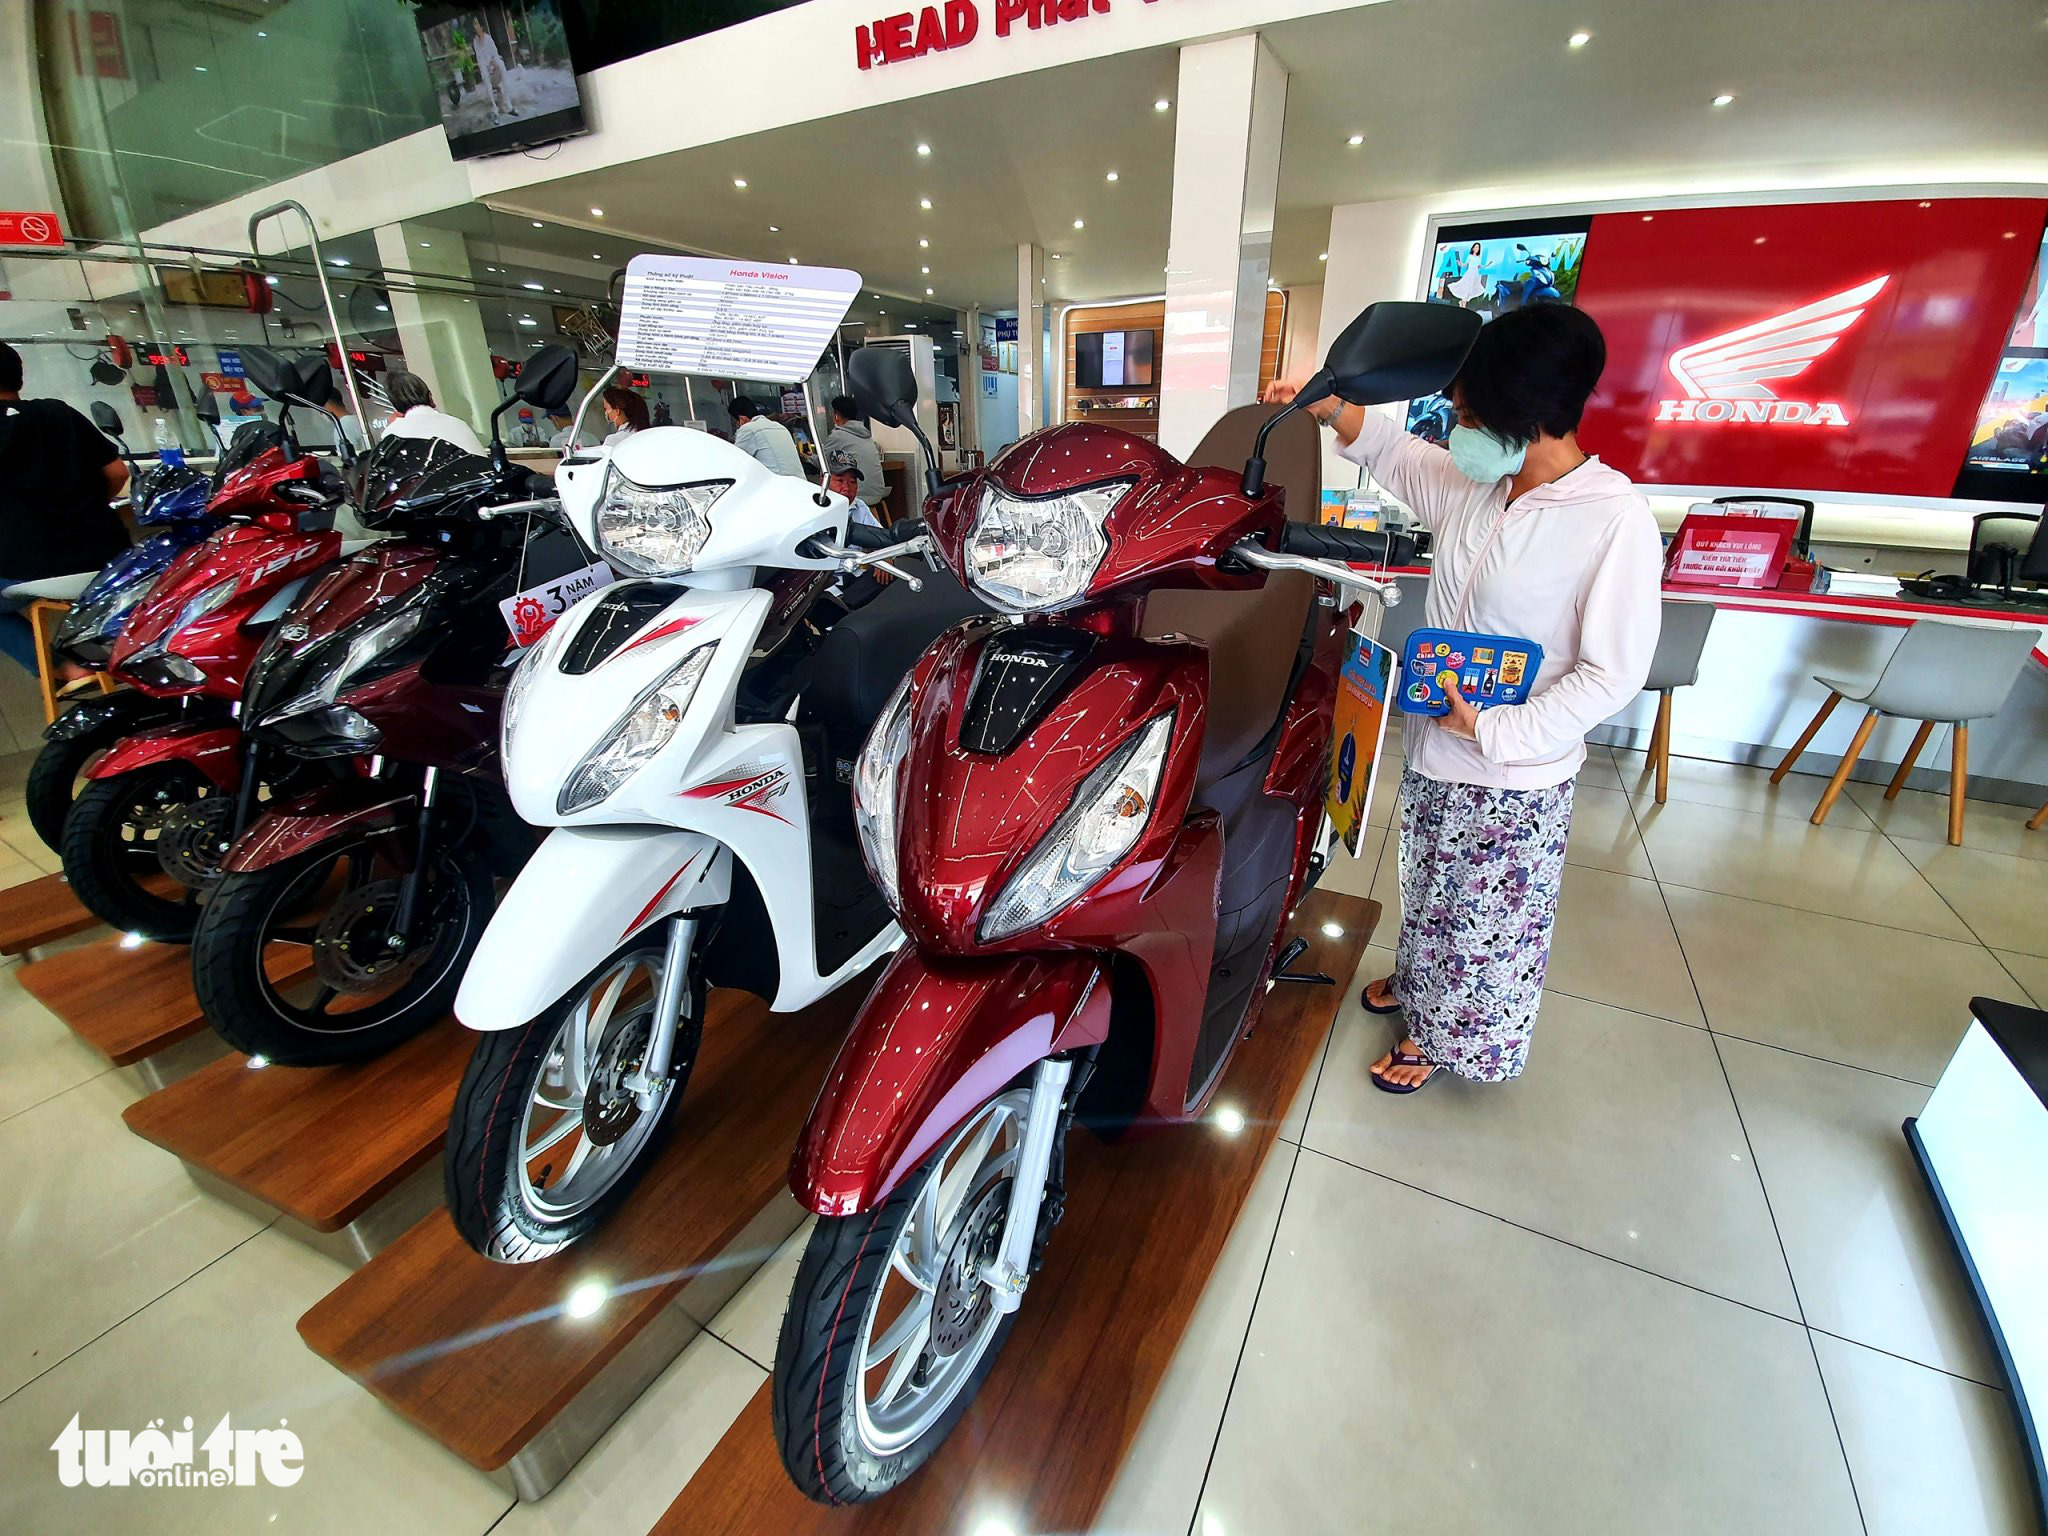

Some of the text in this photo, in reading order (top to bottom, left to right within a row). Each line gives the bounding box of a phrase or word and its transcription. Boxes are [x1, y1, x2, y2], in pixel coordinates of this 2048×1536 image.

[856, 0, 978, 71] HEAD
[730, 269, 789, 281] Honda Vision
[1654, 400, 1850, 426] HONDA
[249, 541, 322, 587] 150
[546, 585, 567, 615] 3
[565, 576, 596, 597] NĂM
[989, 653, 1049, 669] HONDA
[728, 769, 786, 801] HONDA
[760, 781, 790, 806] FI
